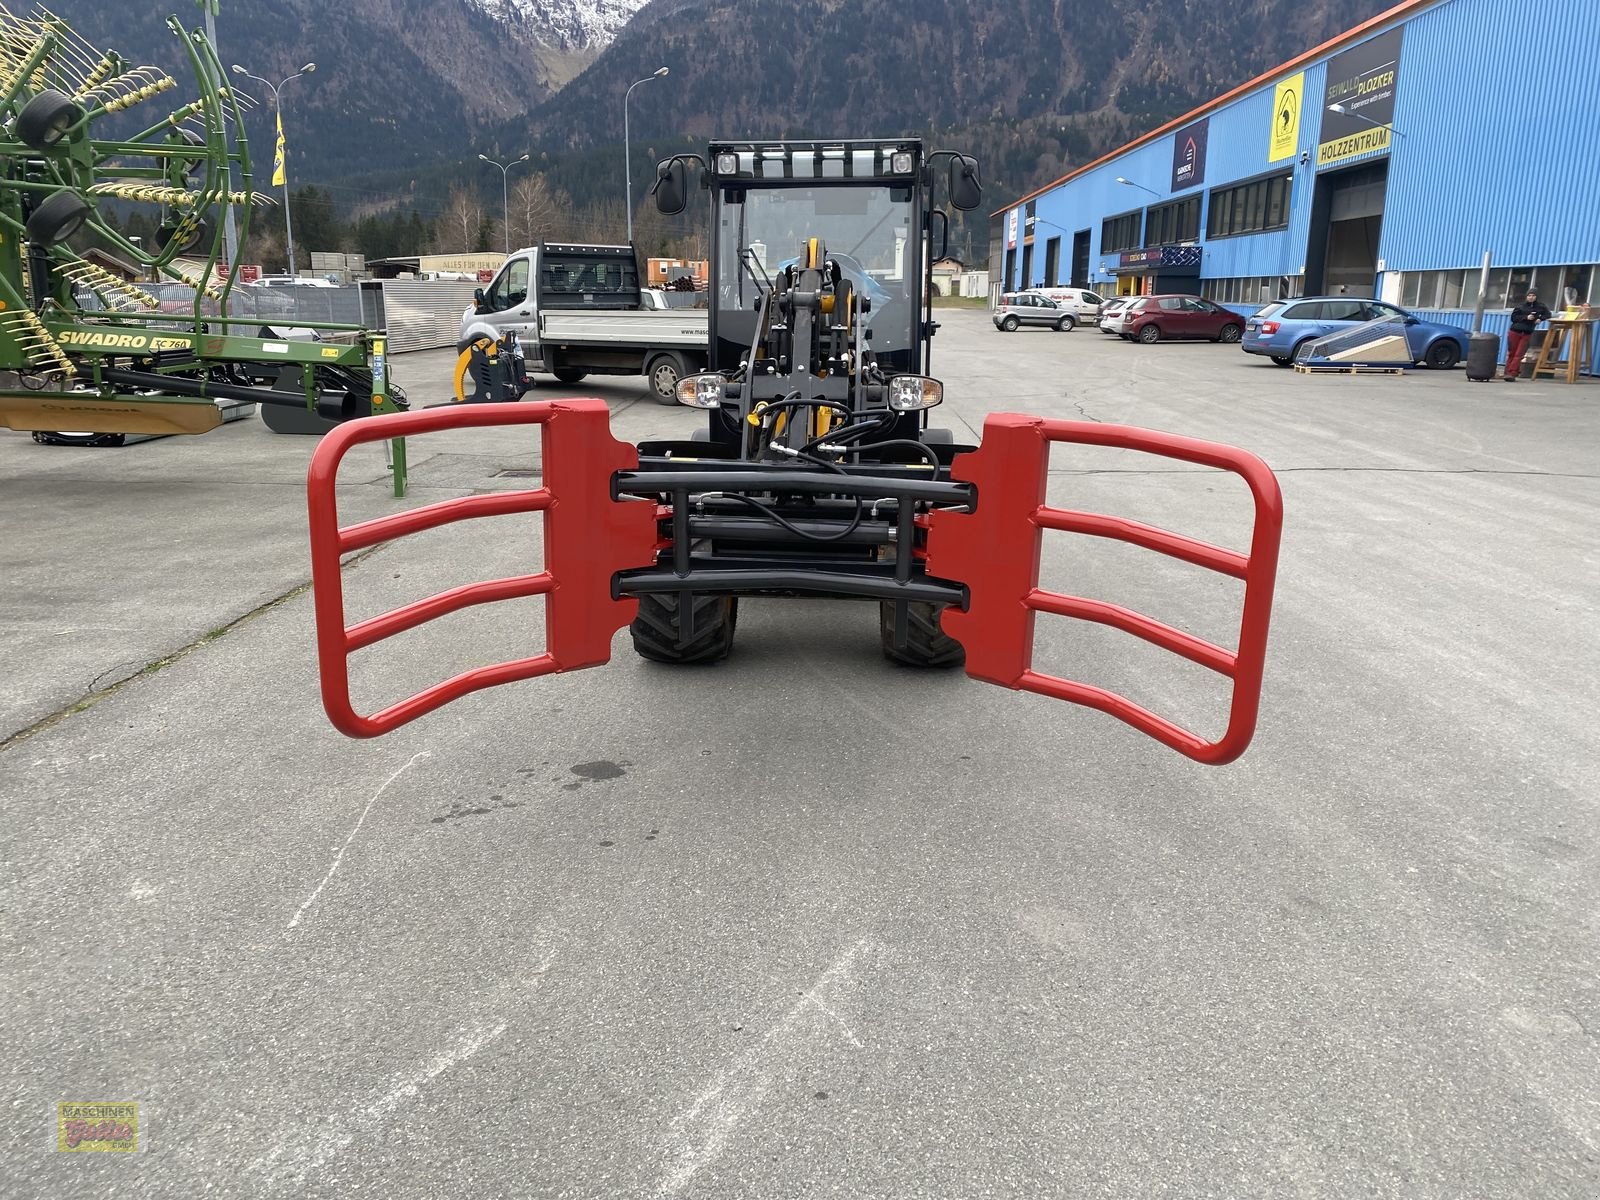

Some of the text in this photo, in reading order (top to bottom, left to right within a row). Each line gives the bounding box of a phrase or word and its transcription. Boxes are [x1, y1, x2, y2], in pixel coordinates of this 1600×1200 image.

[1321, 128, 1387, 160] HOLZZENTRUM
[56, 331, 147, 348] SWADRO
[169, 340, 187, 349] 760
